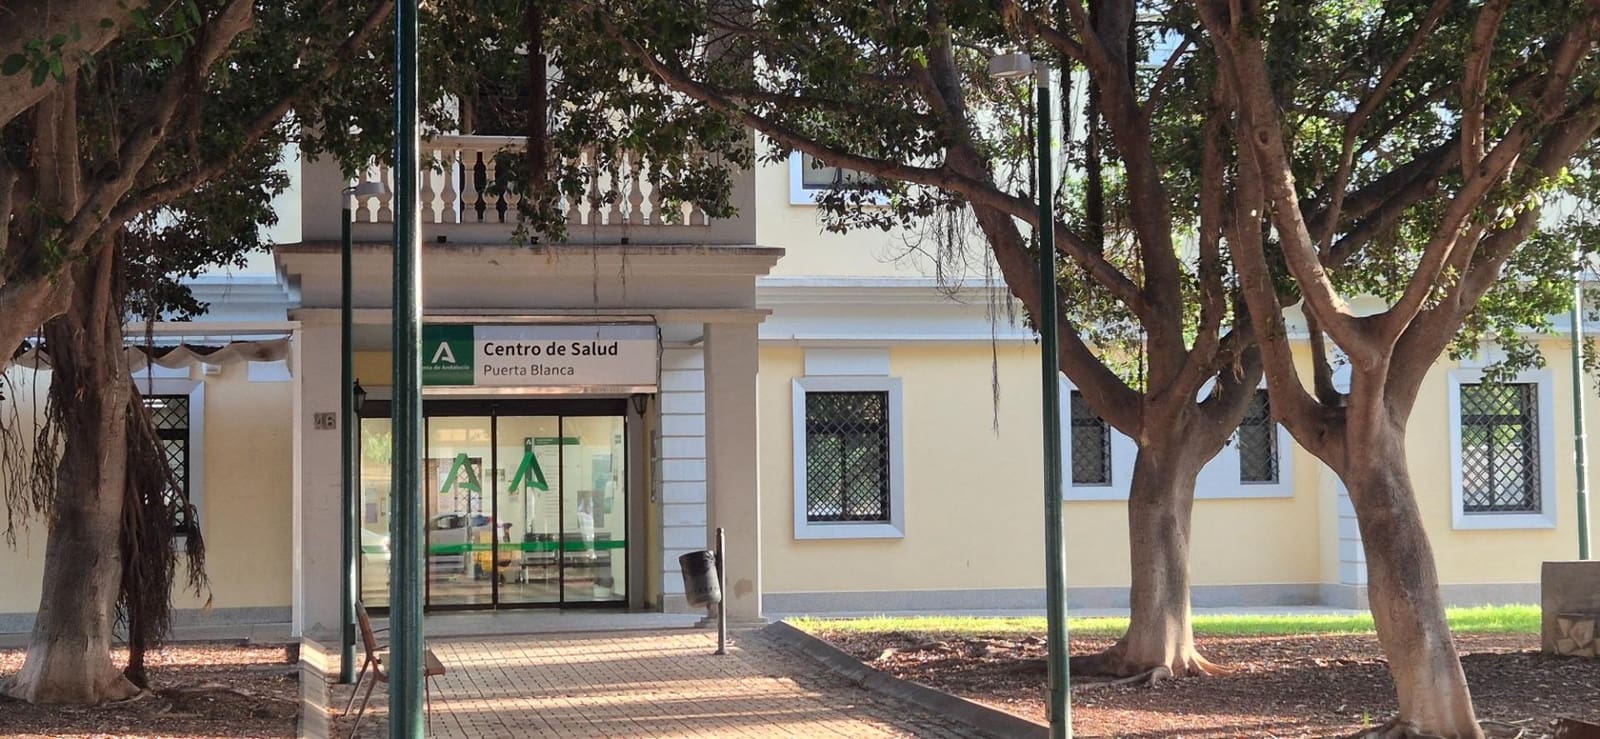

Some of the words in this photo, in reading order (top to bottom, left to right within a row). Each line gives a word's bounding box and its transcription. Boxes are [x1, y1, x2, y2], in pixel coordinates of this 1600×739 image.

[484, 342, 541, 356] Centro
[546, 342, 566, 356] de
[571, 342, 618, 356] Salud
[484, 364, 527, 376] Puerta
[531, 364, 574, 376] Blanca
[314, 413, 335, 429] 46
